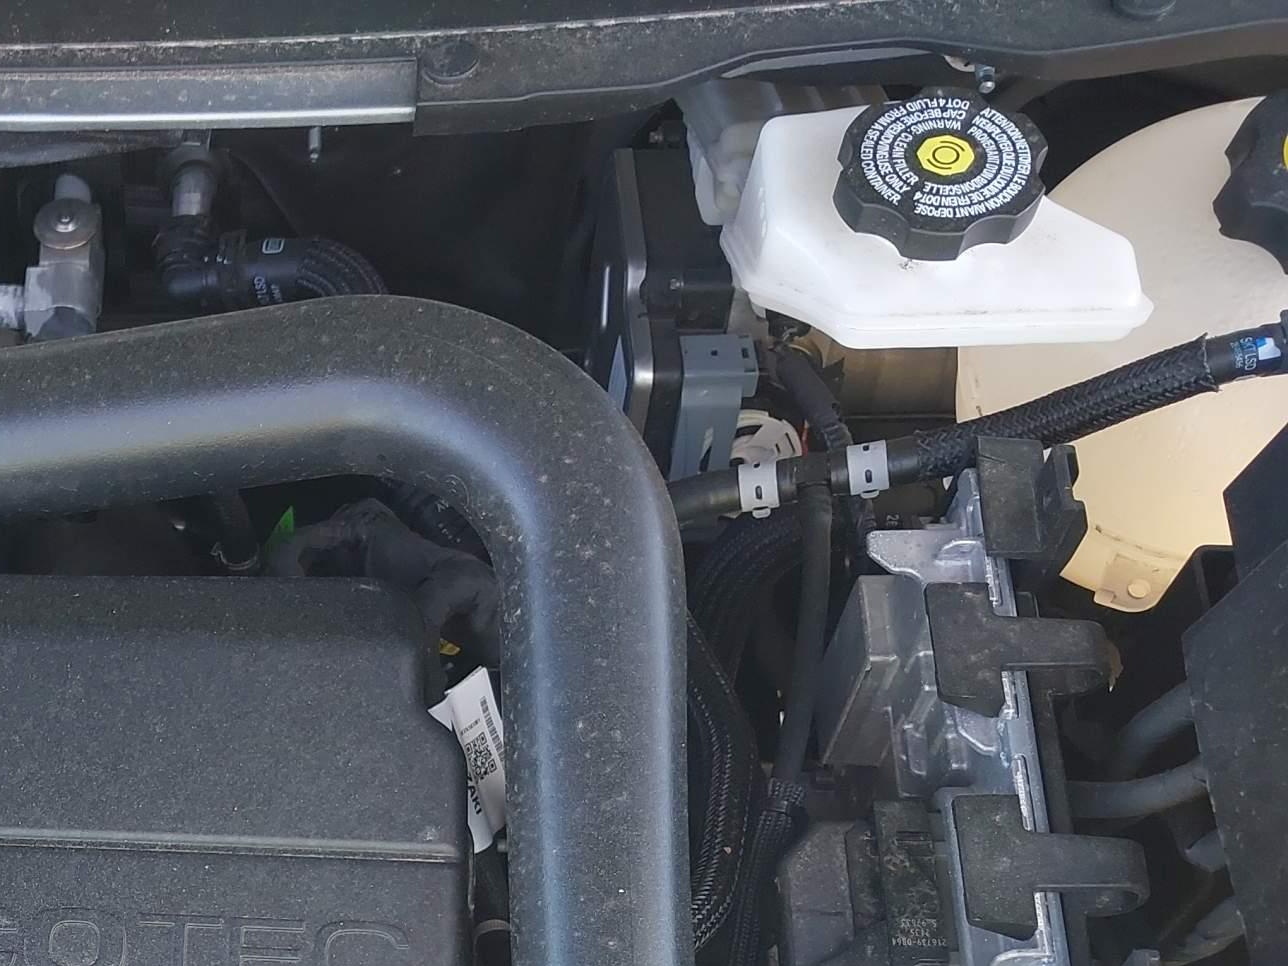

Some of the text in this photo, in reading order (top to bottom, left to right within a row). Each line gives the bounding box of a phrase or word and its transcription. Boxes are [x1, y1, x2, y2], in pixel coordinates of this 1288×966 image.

[905, 97, 938, 112] FLUID
[942, 108, 967, 120] CAP
[876, 105, 908, 127] FROM
[900, 106, 943, 127] BEFORE
[860, 128, 881, 160] SEALED
[891, 119, 962, 186] WARNING: CLEAN FILLER
[966, 125, 1000, 165] PROVENANT
[876, 158, 894, 176] USE
[1002, 151, 1016, 168] QUE
[861, 160, 902, 206] CONTAINER.
[884, 173, 912, 194] ONLY
[923, 182, 963, 195] SCELLE
[959, 174, 989, 194] BIDON
[940, 194, 971, 207] FREIN
[967, 190, 985, 204] DE
[983, 181, 1023, 211] BOUCHON
[954, 202, 987, 218] AVANT
